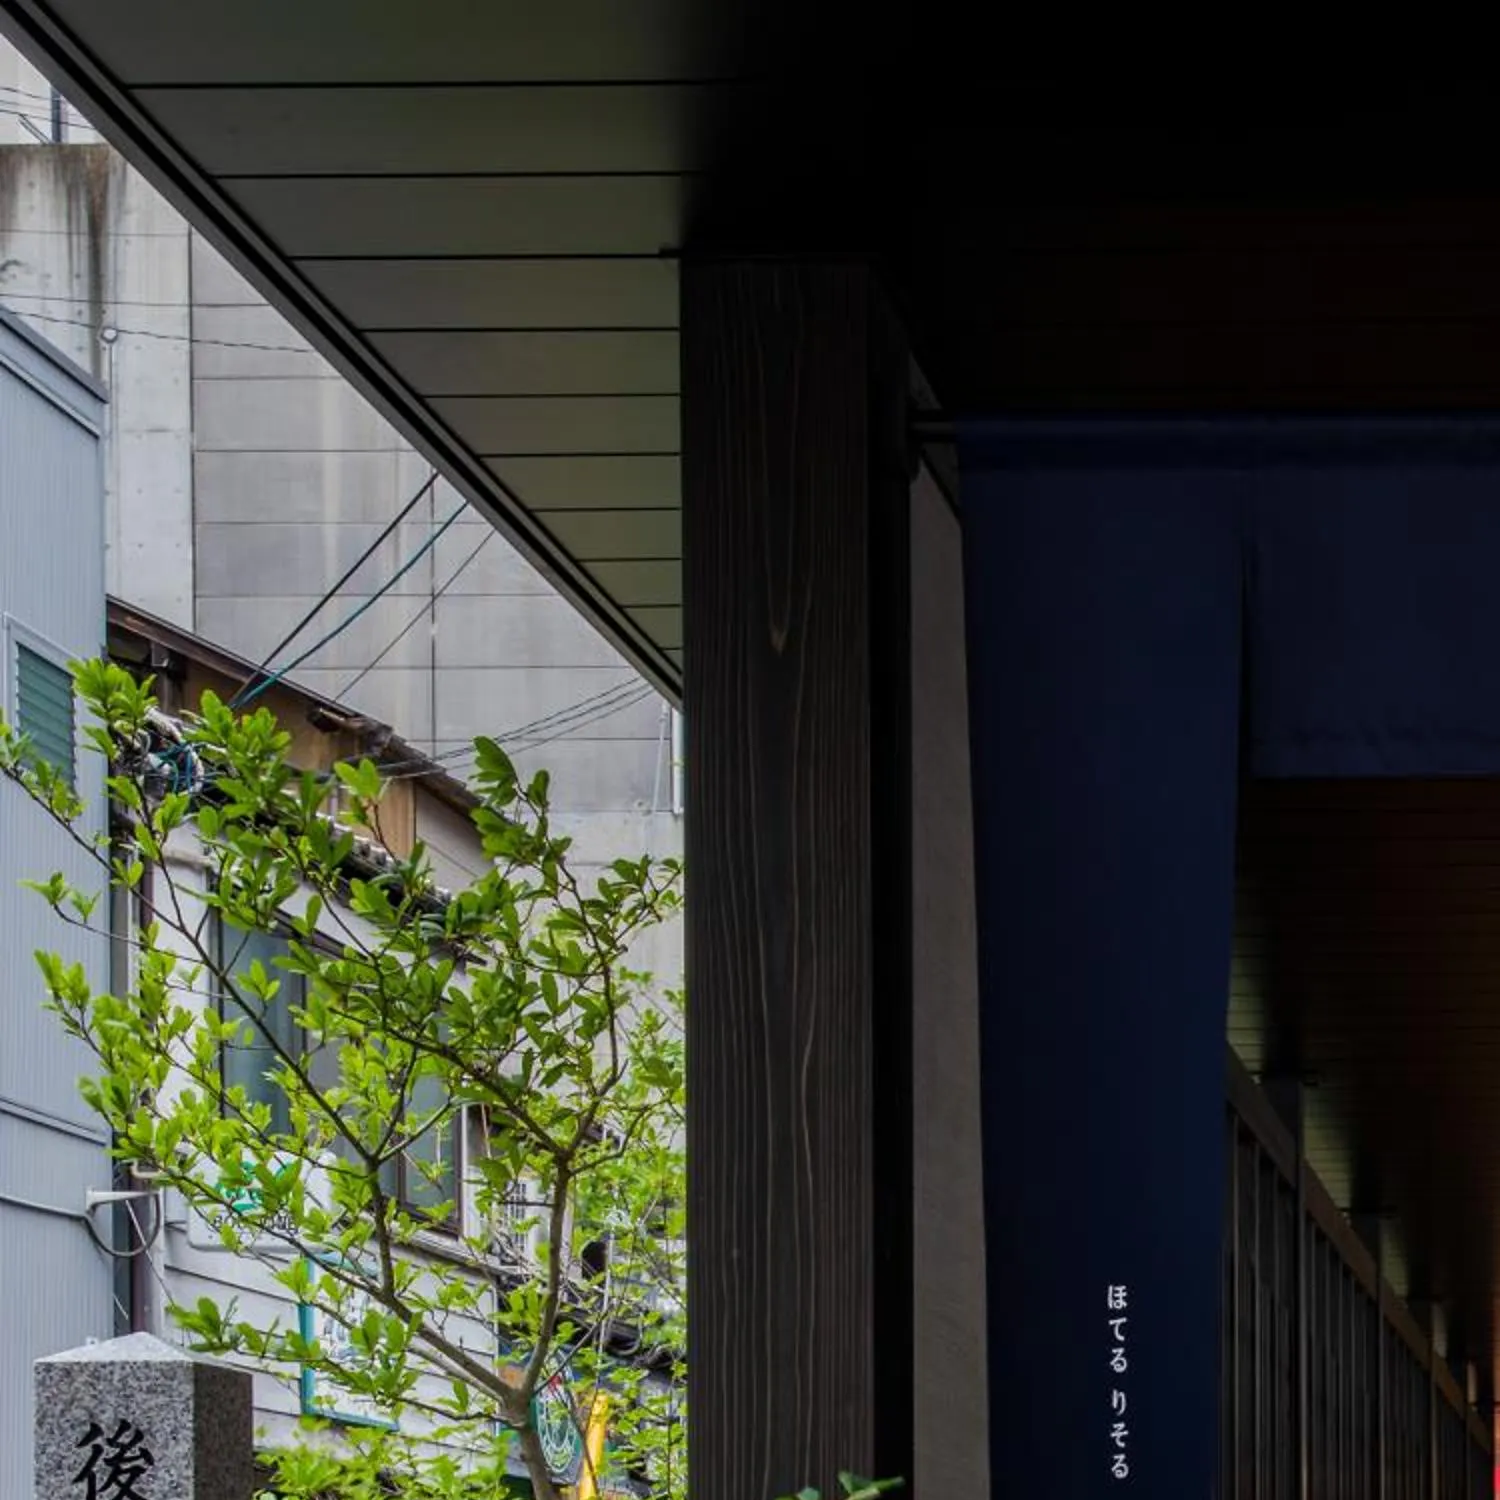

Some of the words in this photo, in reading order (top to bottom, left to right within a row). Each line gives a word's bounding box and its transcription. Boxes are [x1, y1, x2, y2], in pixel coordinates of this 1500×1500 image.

[1107, 1285, 1128, 1373] ほてる
[1110, 1389, 1130, 1479] りそる
